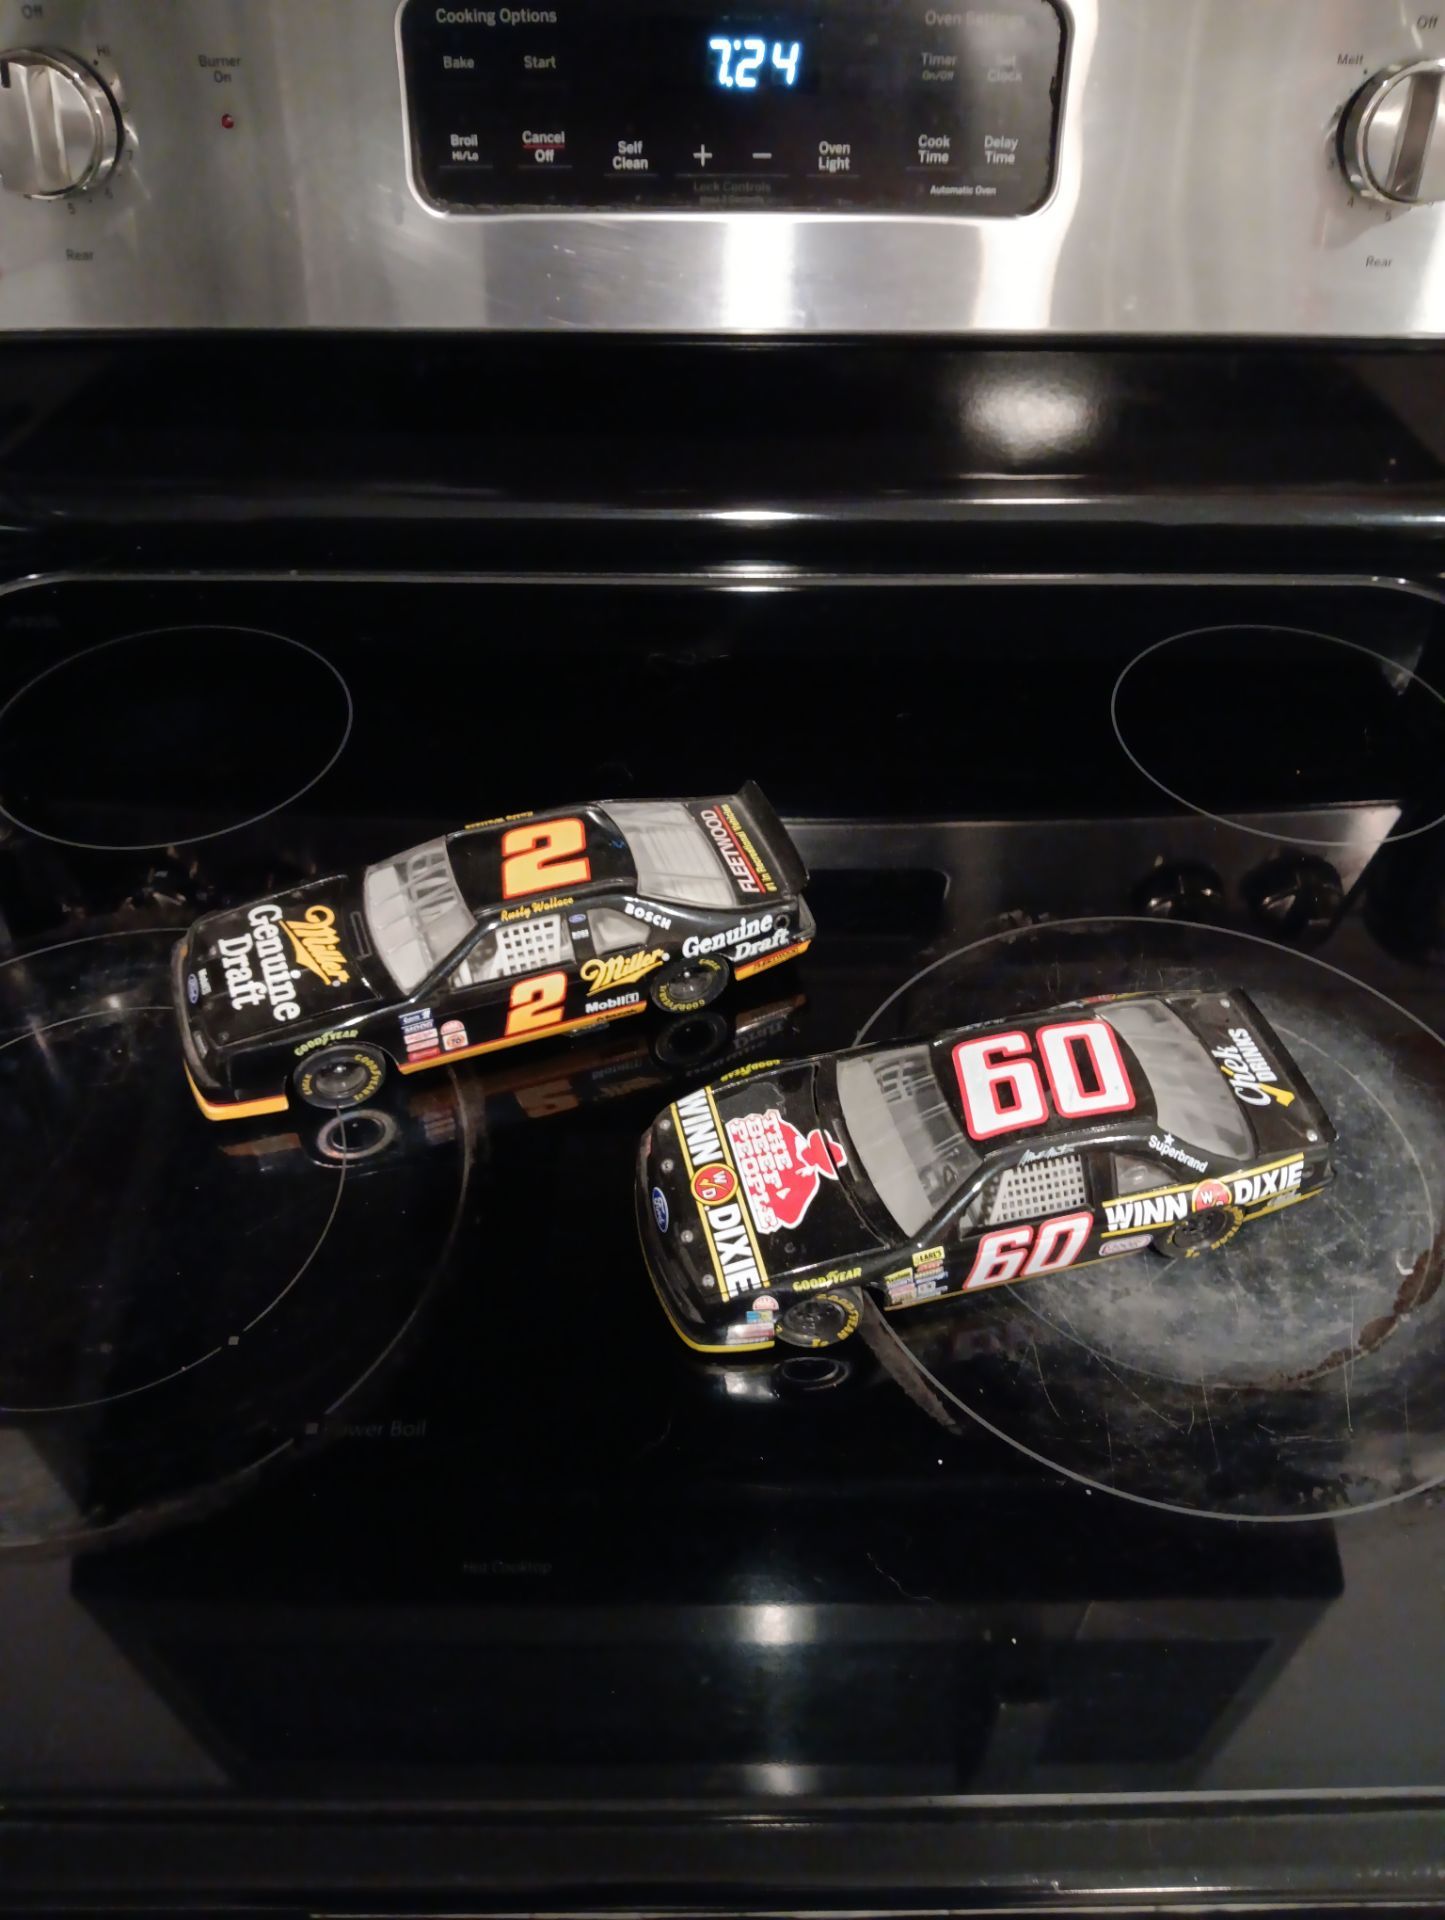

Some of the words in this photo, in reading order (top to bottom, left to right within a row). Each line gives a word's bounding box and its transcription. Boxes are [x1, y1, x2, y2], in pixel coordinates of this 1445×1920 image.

[22, 5, 43, 20] Off
[436, 9, 496, 26] Cooking
[500, 9, 557, 25] Options
[925, 9, 961, 26] Oven
[1417, 16, 1439, 29] Off
[199, 55, 241, 68] Burner
[443, 56, 475, 69] Bake
[524, 56, 556, 69] Start
[709, 36, 801, 88] 7:24
[921, 52, 957, 66] Timer
[1337, 53, 1364, 66] Melt
[214, 72, 232, 83] On
[451, 134, 478, 147] Broil
[522, 131, 565, 144] Cancel
[618, 141, 643, 154] Self
[918, 135, 950, 148] Cook
[984, 136, 1018, 150] Delay
[535, 150, 555, 162] Off
[819, 142, 850, 155] Oven
[918, 151, 949, 164] Time
[985, 151, 1015, 164] Time
[612, 157, 648, 170] Clean
[819, 157, 850, 171] Light
[930, 185, 971, 196] Automatic
[972, 185, 996, 196] Oven
[66, 249, 94, 261] Rear
[1366, 256, 1393, 268] Rear
[502, 817, 591, 899] 2
[701, 809, 760, 892] FLEETWOOD
[501, 903, 532, 922] Rusty
[533, 897, 574, 916] Wallace
[624, 903, 672, 930] BOSCH
[279, 904, 350, 985] Miller
[682, 914, 773, 958] Genuine
[734, 928, 790, 961] Draft
[217, 933, 267, 1010] Draft
[247, 904, 301, 1021] Genuine
[580, 948, 665, 996] Miller
[504, 970, 568, 1036] 2
[294, 1028, 359, 1057] GOODYEAR
[1229, 1028, 1278, 1082] DRINKS
[952, 1019, 1136, 1141] 60
[1212, 1044, 1271, 1106] Chek
[764, 1110, 792, 1170] THE
[745, 1113, 782, 1197] BEEF
[1148, 1134, 1209, 1173] Superbrand
[727, 1119, 779, 1232] PEOPLE
[676, 1089, 723, 1166] WINN
[709, 1203, 763, 1298] DIXIE
[1105, 1192, 1189, 1231] WINN
[1233, 1162, 1305, 1205] DIXIE
[963, 1211, 1093, 1289] 60
[793, 1267, 863, 1292] GOODYEAR
